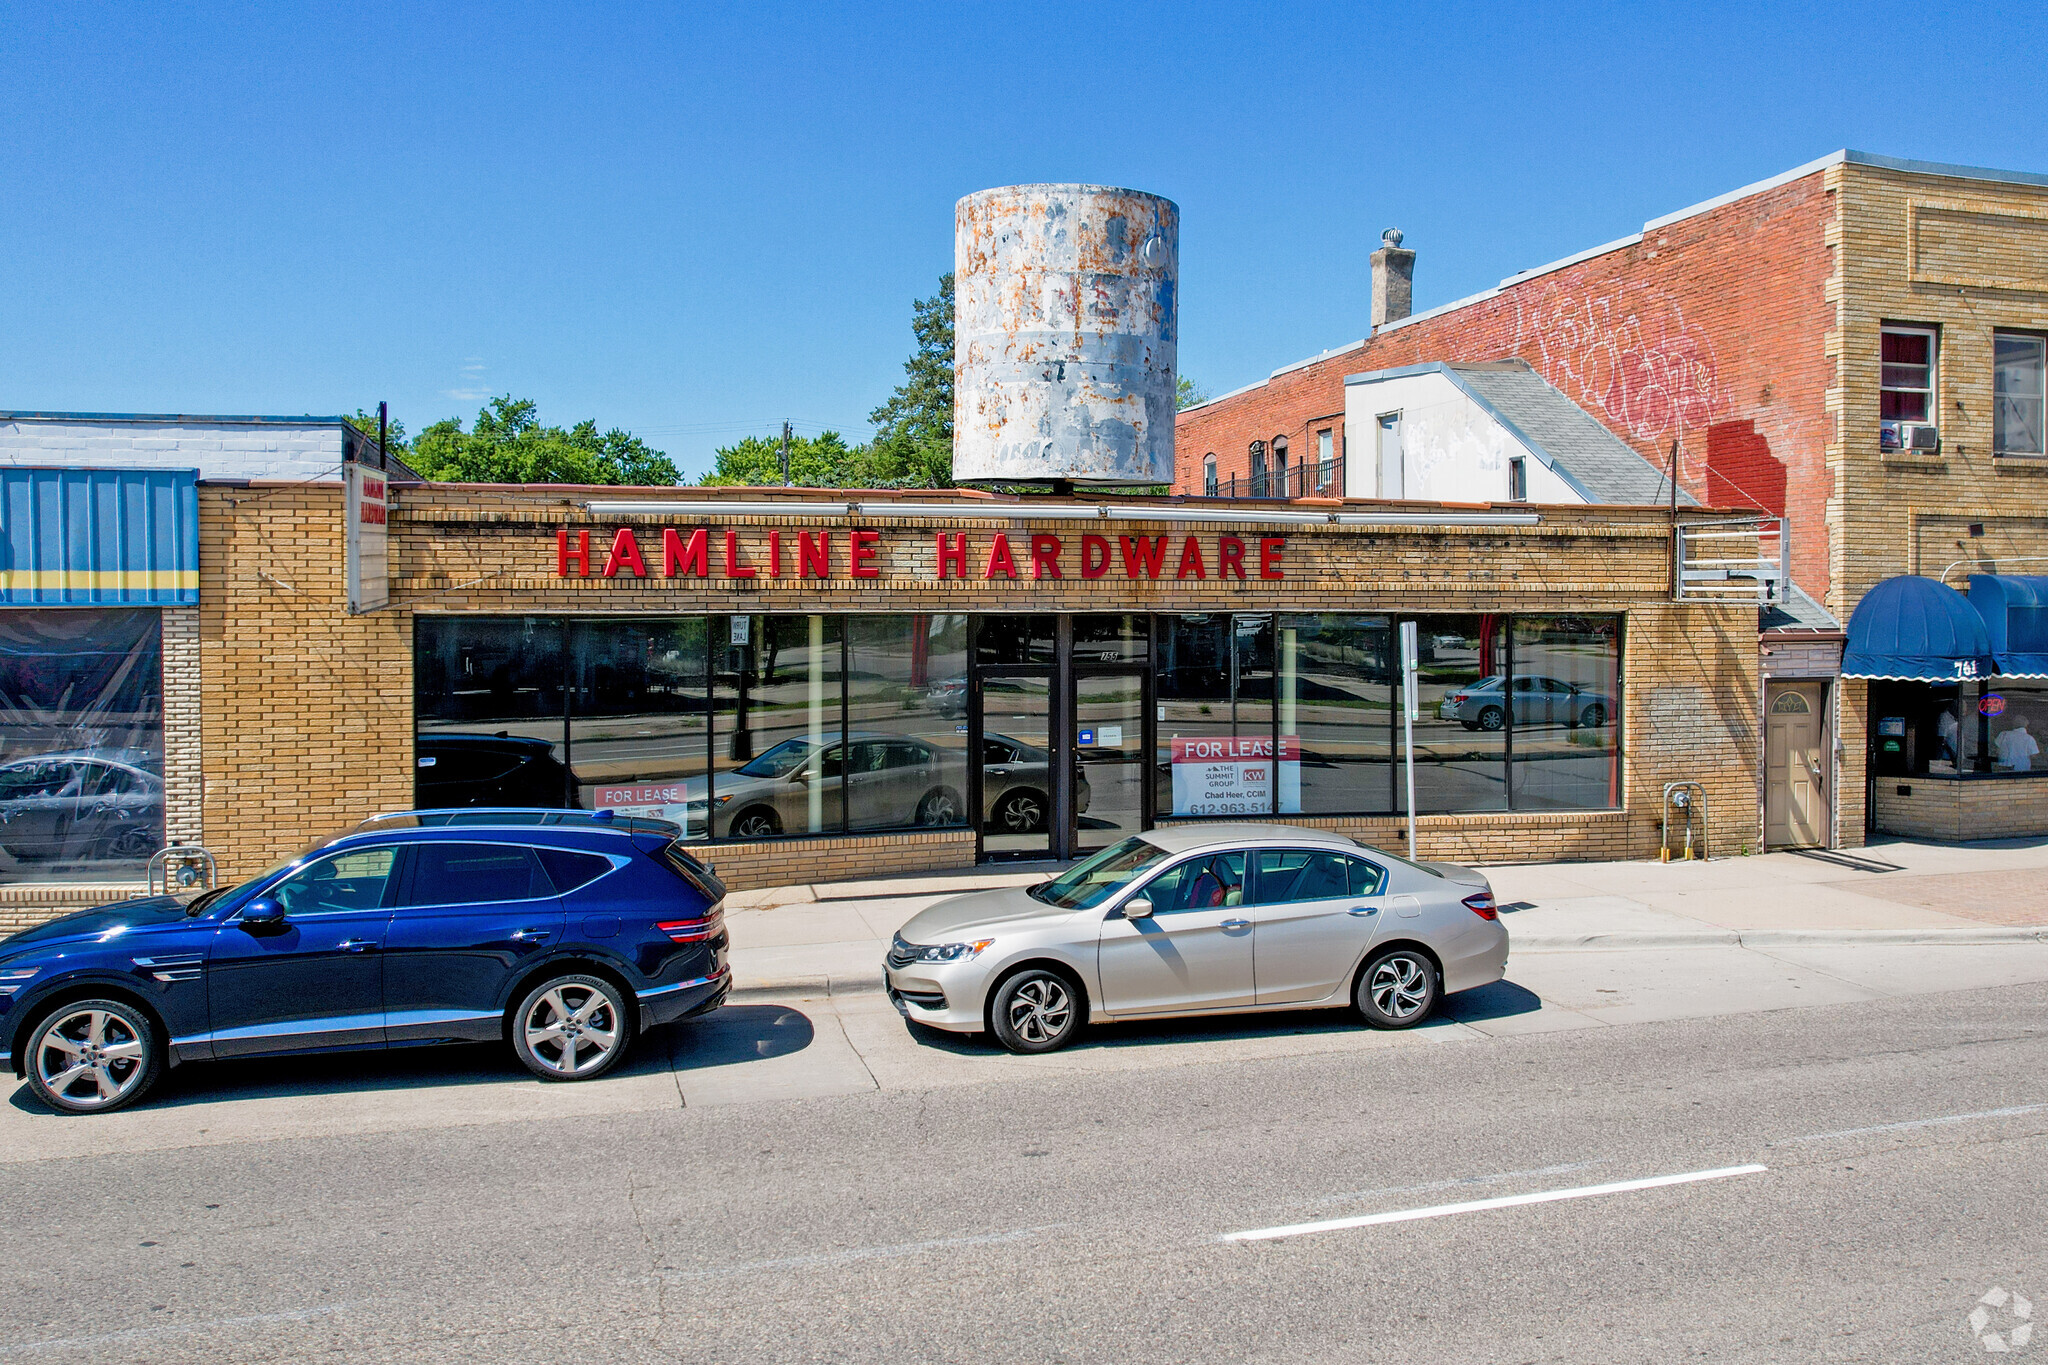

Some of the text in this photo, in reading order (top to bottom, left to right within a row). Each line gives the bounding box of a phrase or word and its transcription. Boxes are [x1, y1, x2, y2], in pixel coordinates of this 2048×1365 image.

[556, 527, 1286, 580] HAMLINE HARDWARE
[1954, 660, 1977, 677] 761
[1978, 698, 2005, 712] OPEN
[1185, 740, 1287, 758] FOR LEASE
[1205, 772, 1234, 780] SUMMIT
[1244, 771, 1265, 780] KW
[605, 788, 678, 803] FOR LEASE
[1204, 790, 1266, 799] Chad Heer, CCIM
